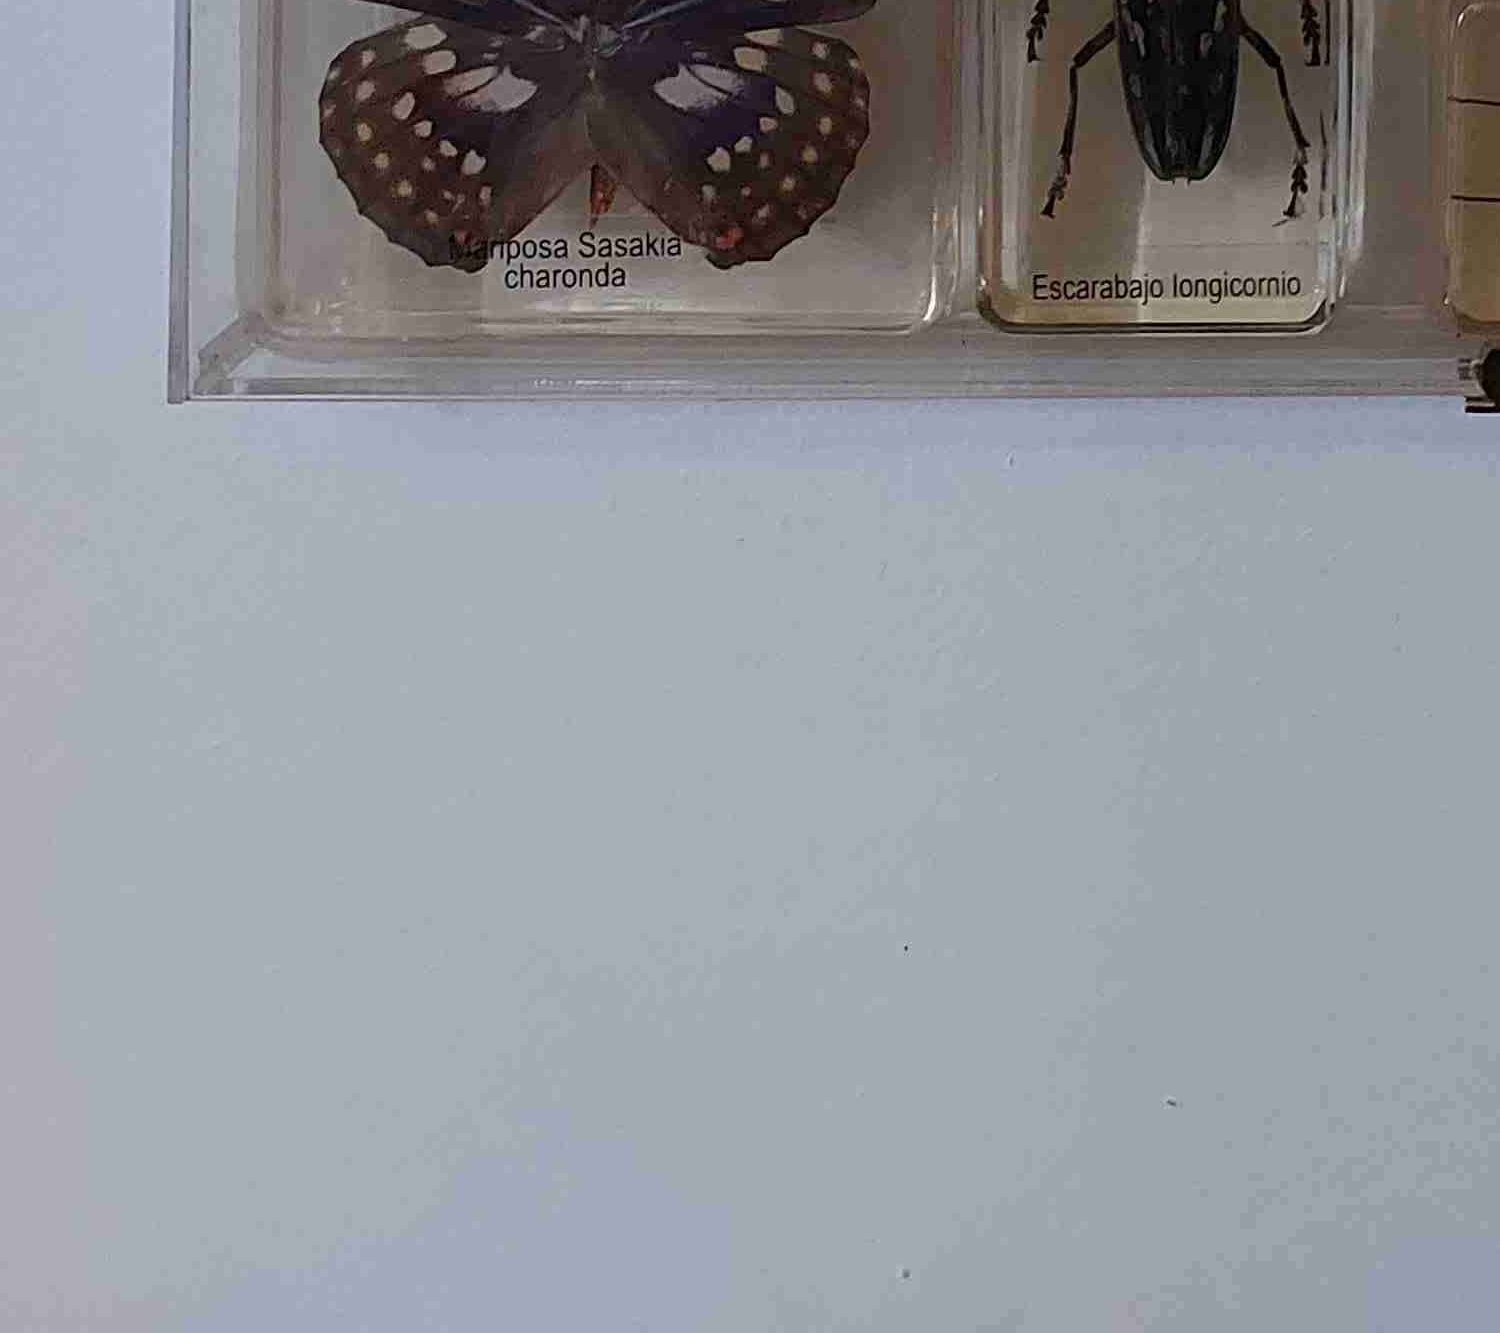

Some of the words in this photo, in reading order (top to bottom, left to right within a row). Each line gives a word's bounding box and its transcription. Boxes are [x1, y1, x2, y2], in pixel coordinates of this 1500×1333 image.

[578, 232, 682, 259] Sasakia
[505, 262, 626, 289] charonda
[1032, 274, 1163, 305] Escarabajo
[1173, 271, 1301, 304] longicornio
